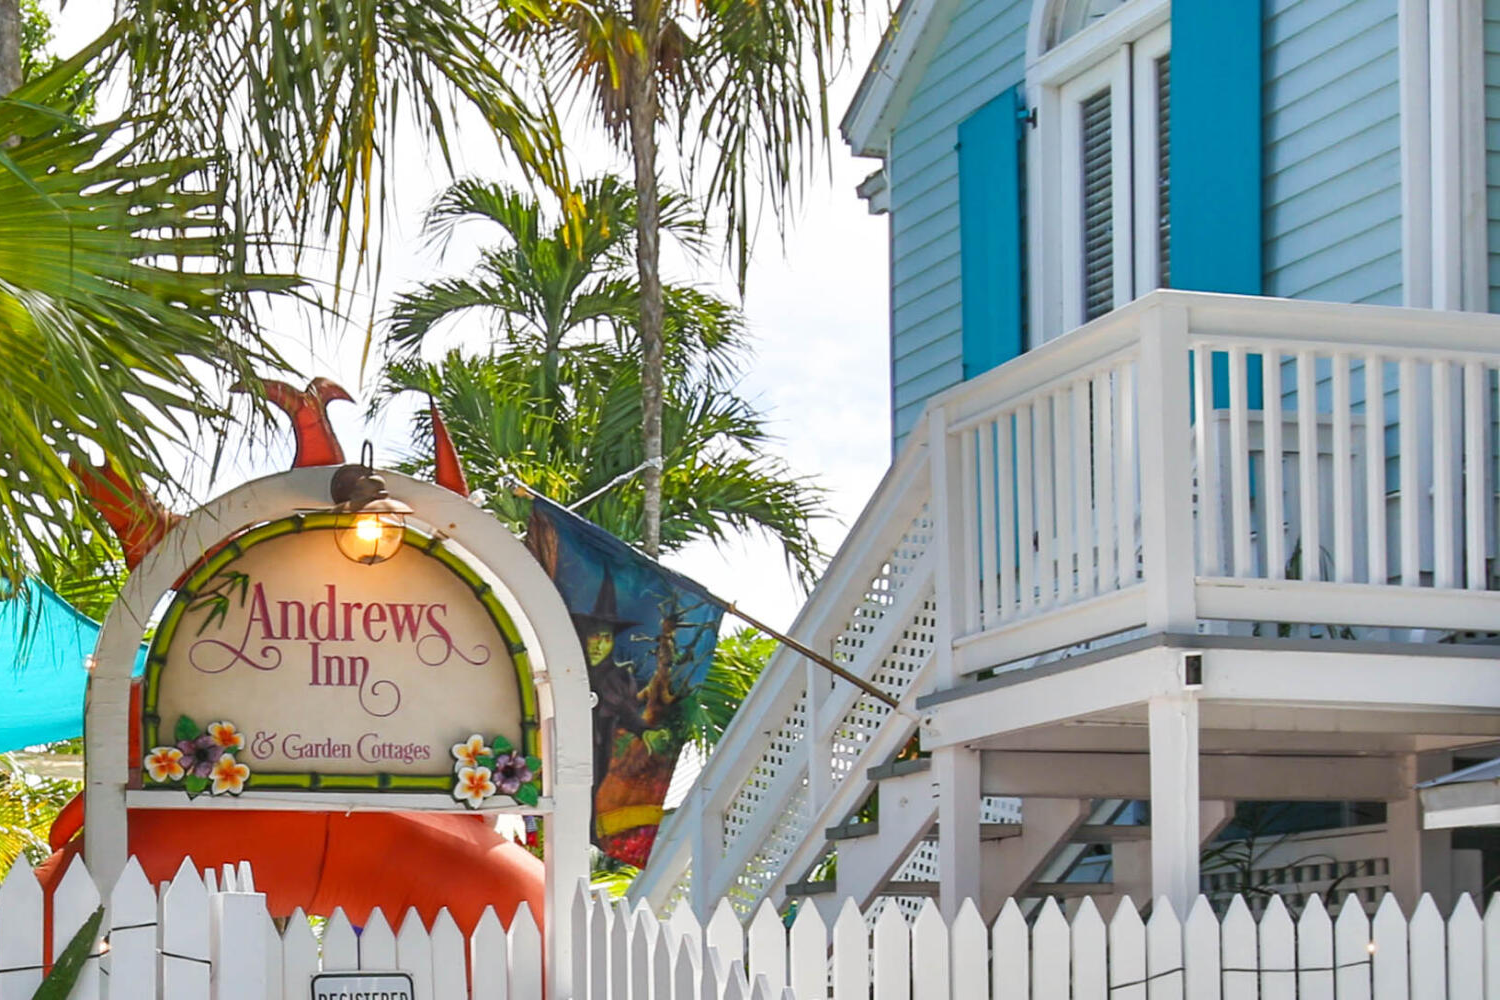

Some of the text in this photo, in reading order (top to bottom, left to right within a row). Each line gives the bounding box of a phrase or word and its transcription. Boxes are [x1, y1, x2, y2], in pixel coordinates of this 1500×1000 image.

[189, 582, 491, 673] Andrews
[308, 641, 401, 717] Inn
[251, 731, 431, 763] & Garden Cottages
